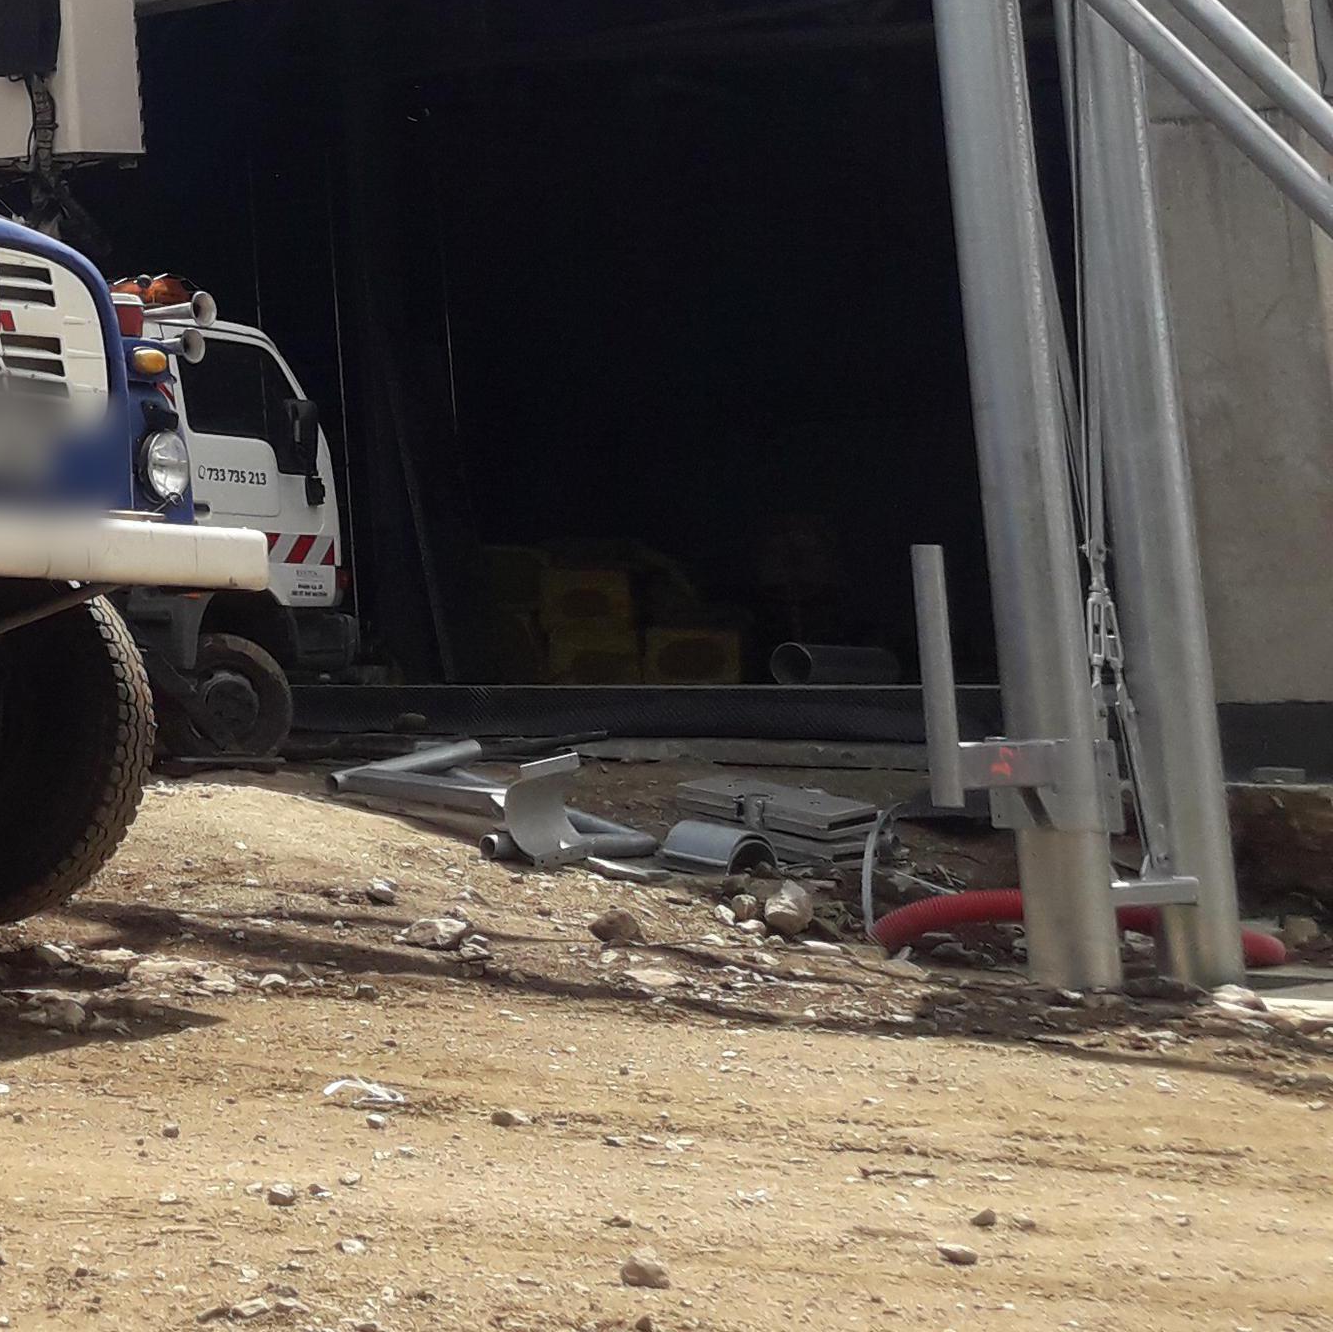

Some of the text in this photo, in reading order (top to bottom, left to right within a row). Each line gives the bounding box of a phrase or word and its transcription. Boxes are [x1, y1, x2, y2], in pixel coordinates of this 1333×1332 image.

[206, 467, 267, 486] 733 735 213
